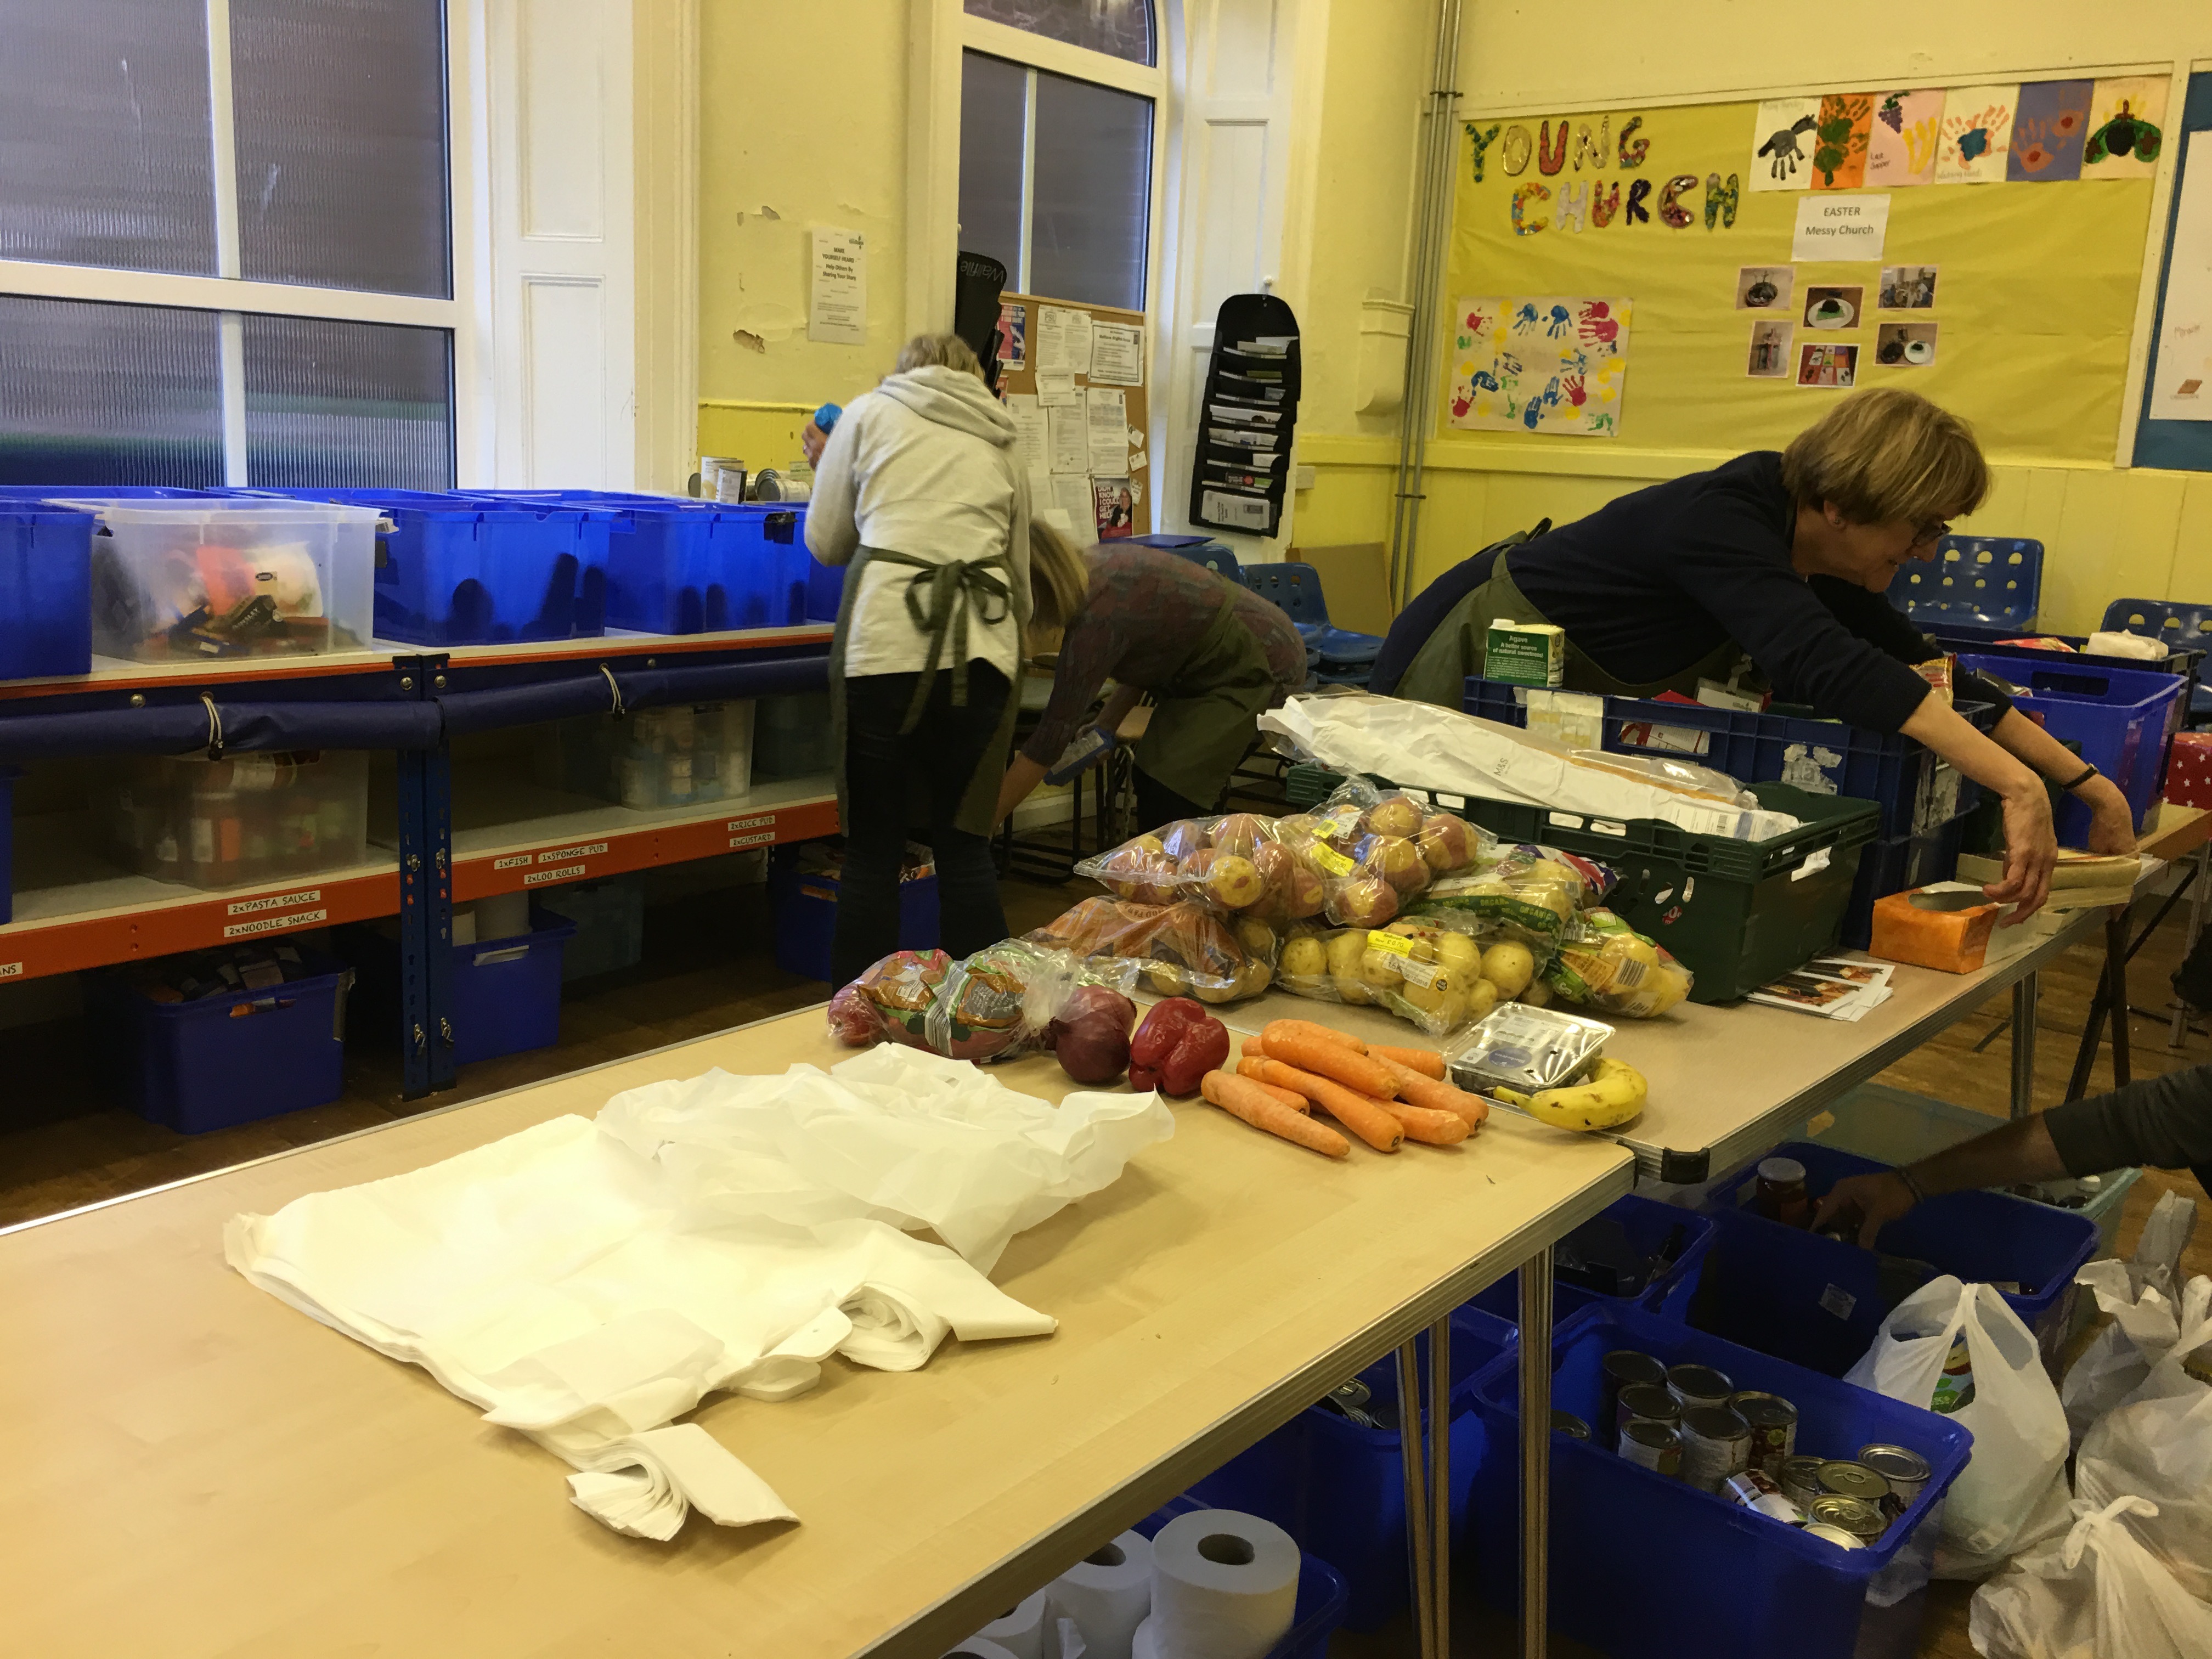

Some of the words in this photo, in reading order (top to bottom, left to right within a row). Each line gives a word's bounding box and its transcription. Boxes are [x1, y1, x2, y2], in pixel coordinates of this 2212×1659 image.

[1465, 116, 1650, 182] YOUNG
[1511, 172, 1739, 235] CHURCH
[1824, 207, 1861, 216] EASTER
[1805, 227, 1836, 236] Messy
[1839, 224, 1874, 235] Church
[961, 261, 1004, 283] Wallfile
[1493, 758, 1508, 776] M&S
[759, 817, 773, 825] PUD
[589, 845, 604, 854] PUD
[556, 867, 580, 878] ROLLS
[282, 892, 315, 905] SAUCE
[287, 911, 320, 925] SNACK
[1519, 906, 1551, 921] ORGANIC
[1383, 933, 1403, 941] Reduced
[0, 965, 16, 975] NS
